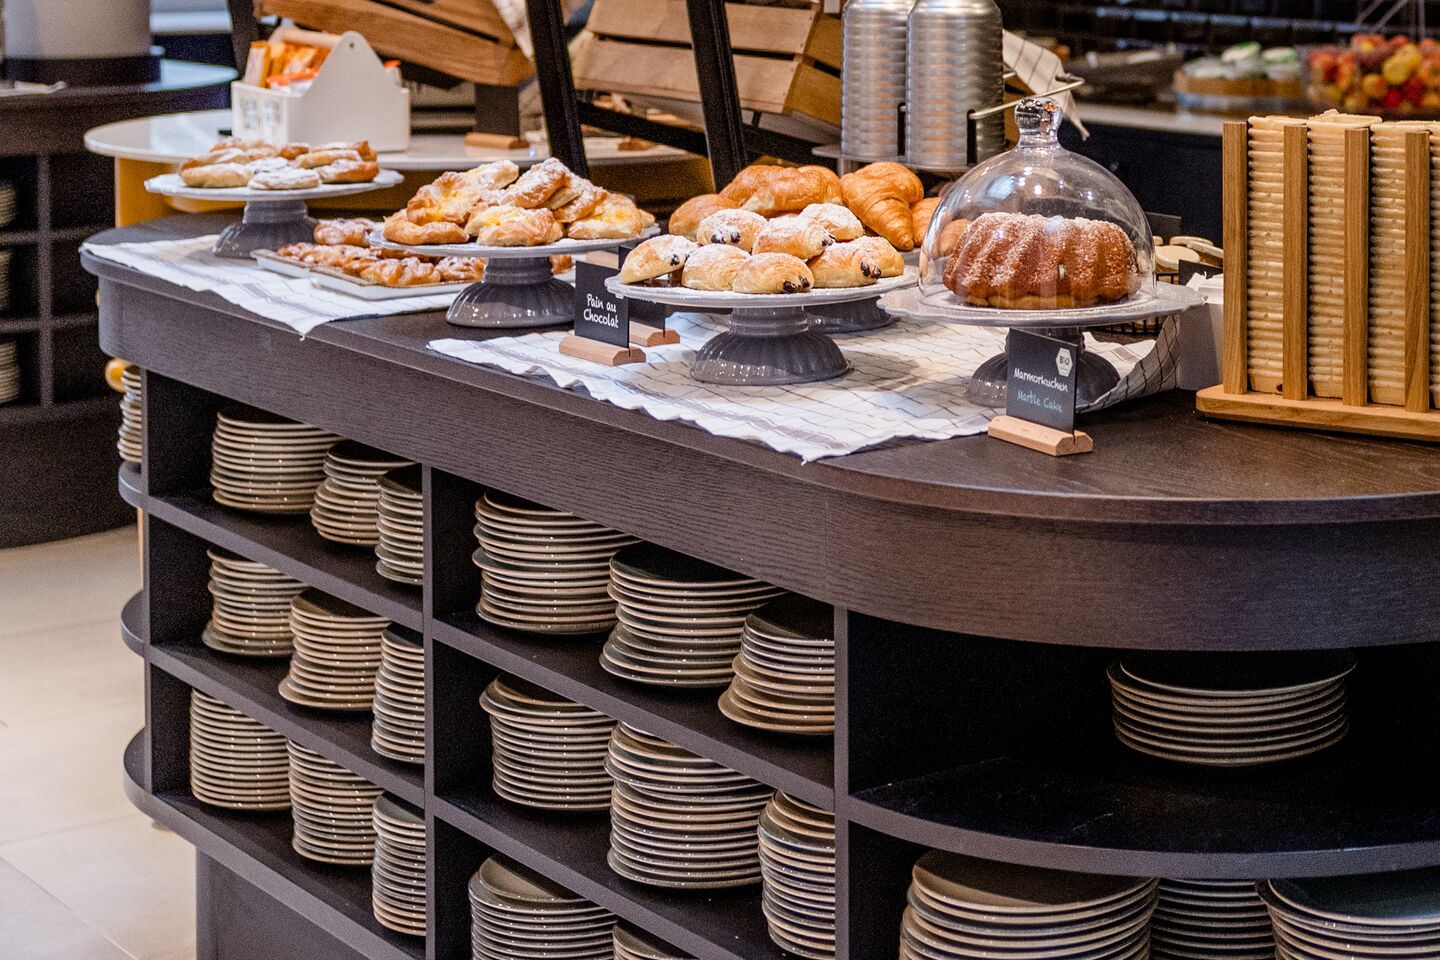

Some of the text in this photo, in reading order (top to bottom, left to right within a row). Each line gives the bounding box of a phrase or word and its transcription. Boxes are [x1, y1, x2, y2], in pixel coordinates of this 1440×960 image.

[586, 293, 617, 313] Pain au
[583, 308, 619, 328] Chocolat
[1013, 367, 1069, 392] Marmorkuchen
[1017, 390, 1064, 413] Marble Cake
